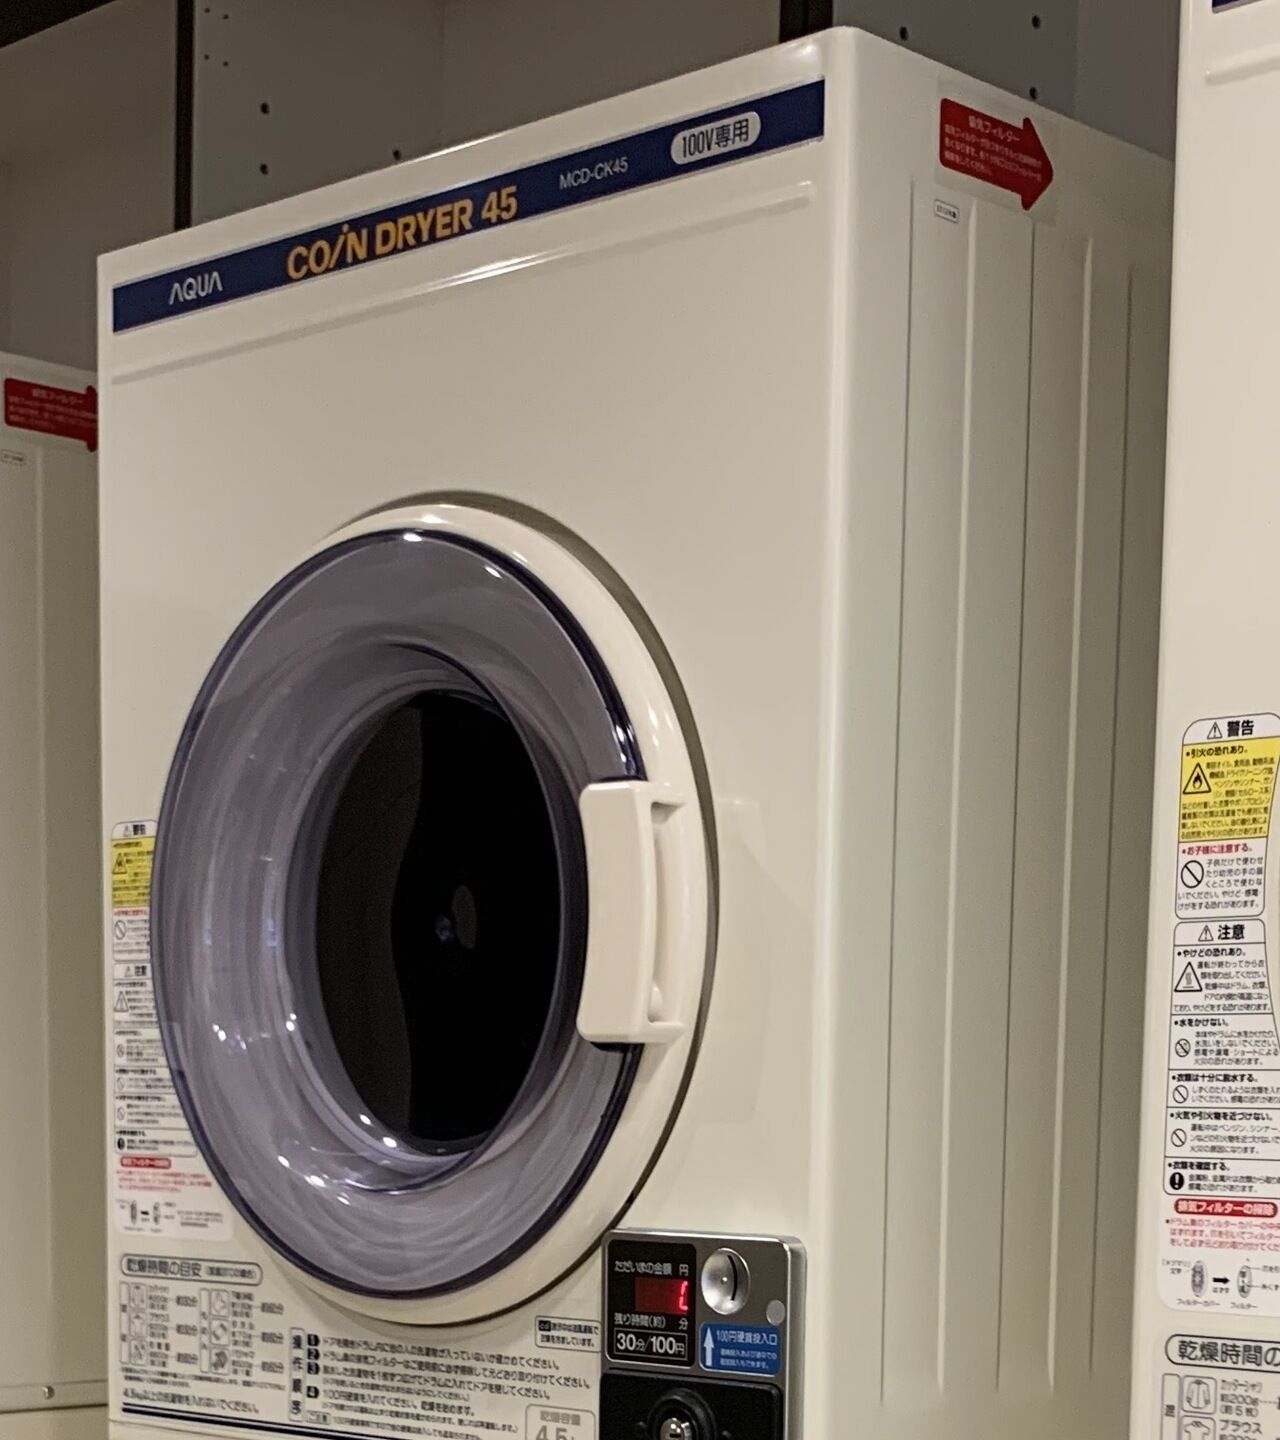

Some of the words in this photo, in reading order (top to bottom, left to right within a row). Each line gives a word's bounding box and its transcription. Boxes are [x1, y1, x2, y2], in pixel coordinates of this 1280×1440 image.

[681, 118, 749, 159] 100V専用
[169, 271, 223, 305] AQUA
[374, 198, 474, 257] DRYER
[481, 185, 519, 225] 45
[558, 156, 629, 190] MCD-CK45
[1227, 719, 1255, 738] 警告
[1217, 924, 1245, 940] 注意
[678, 1263, 689, 1277] 円
[678, 1318, 689, 1331] 分
